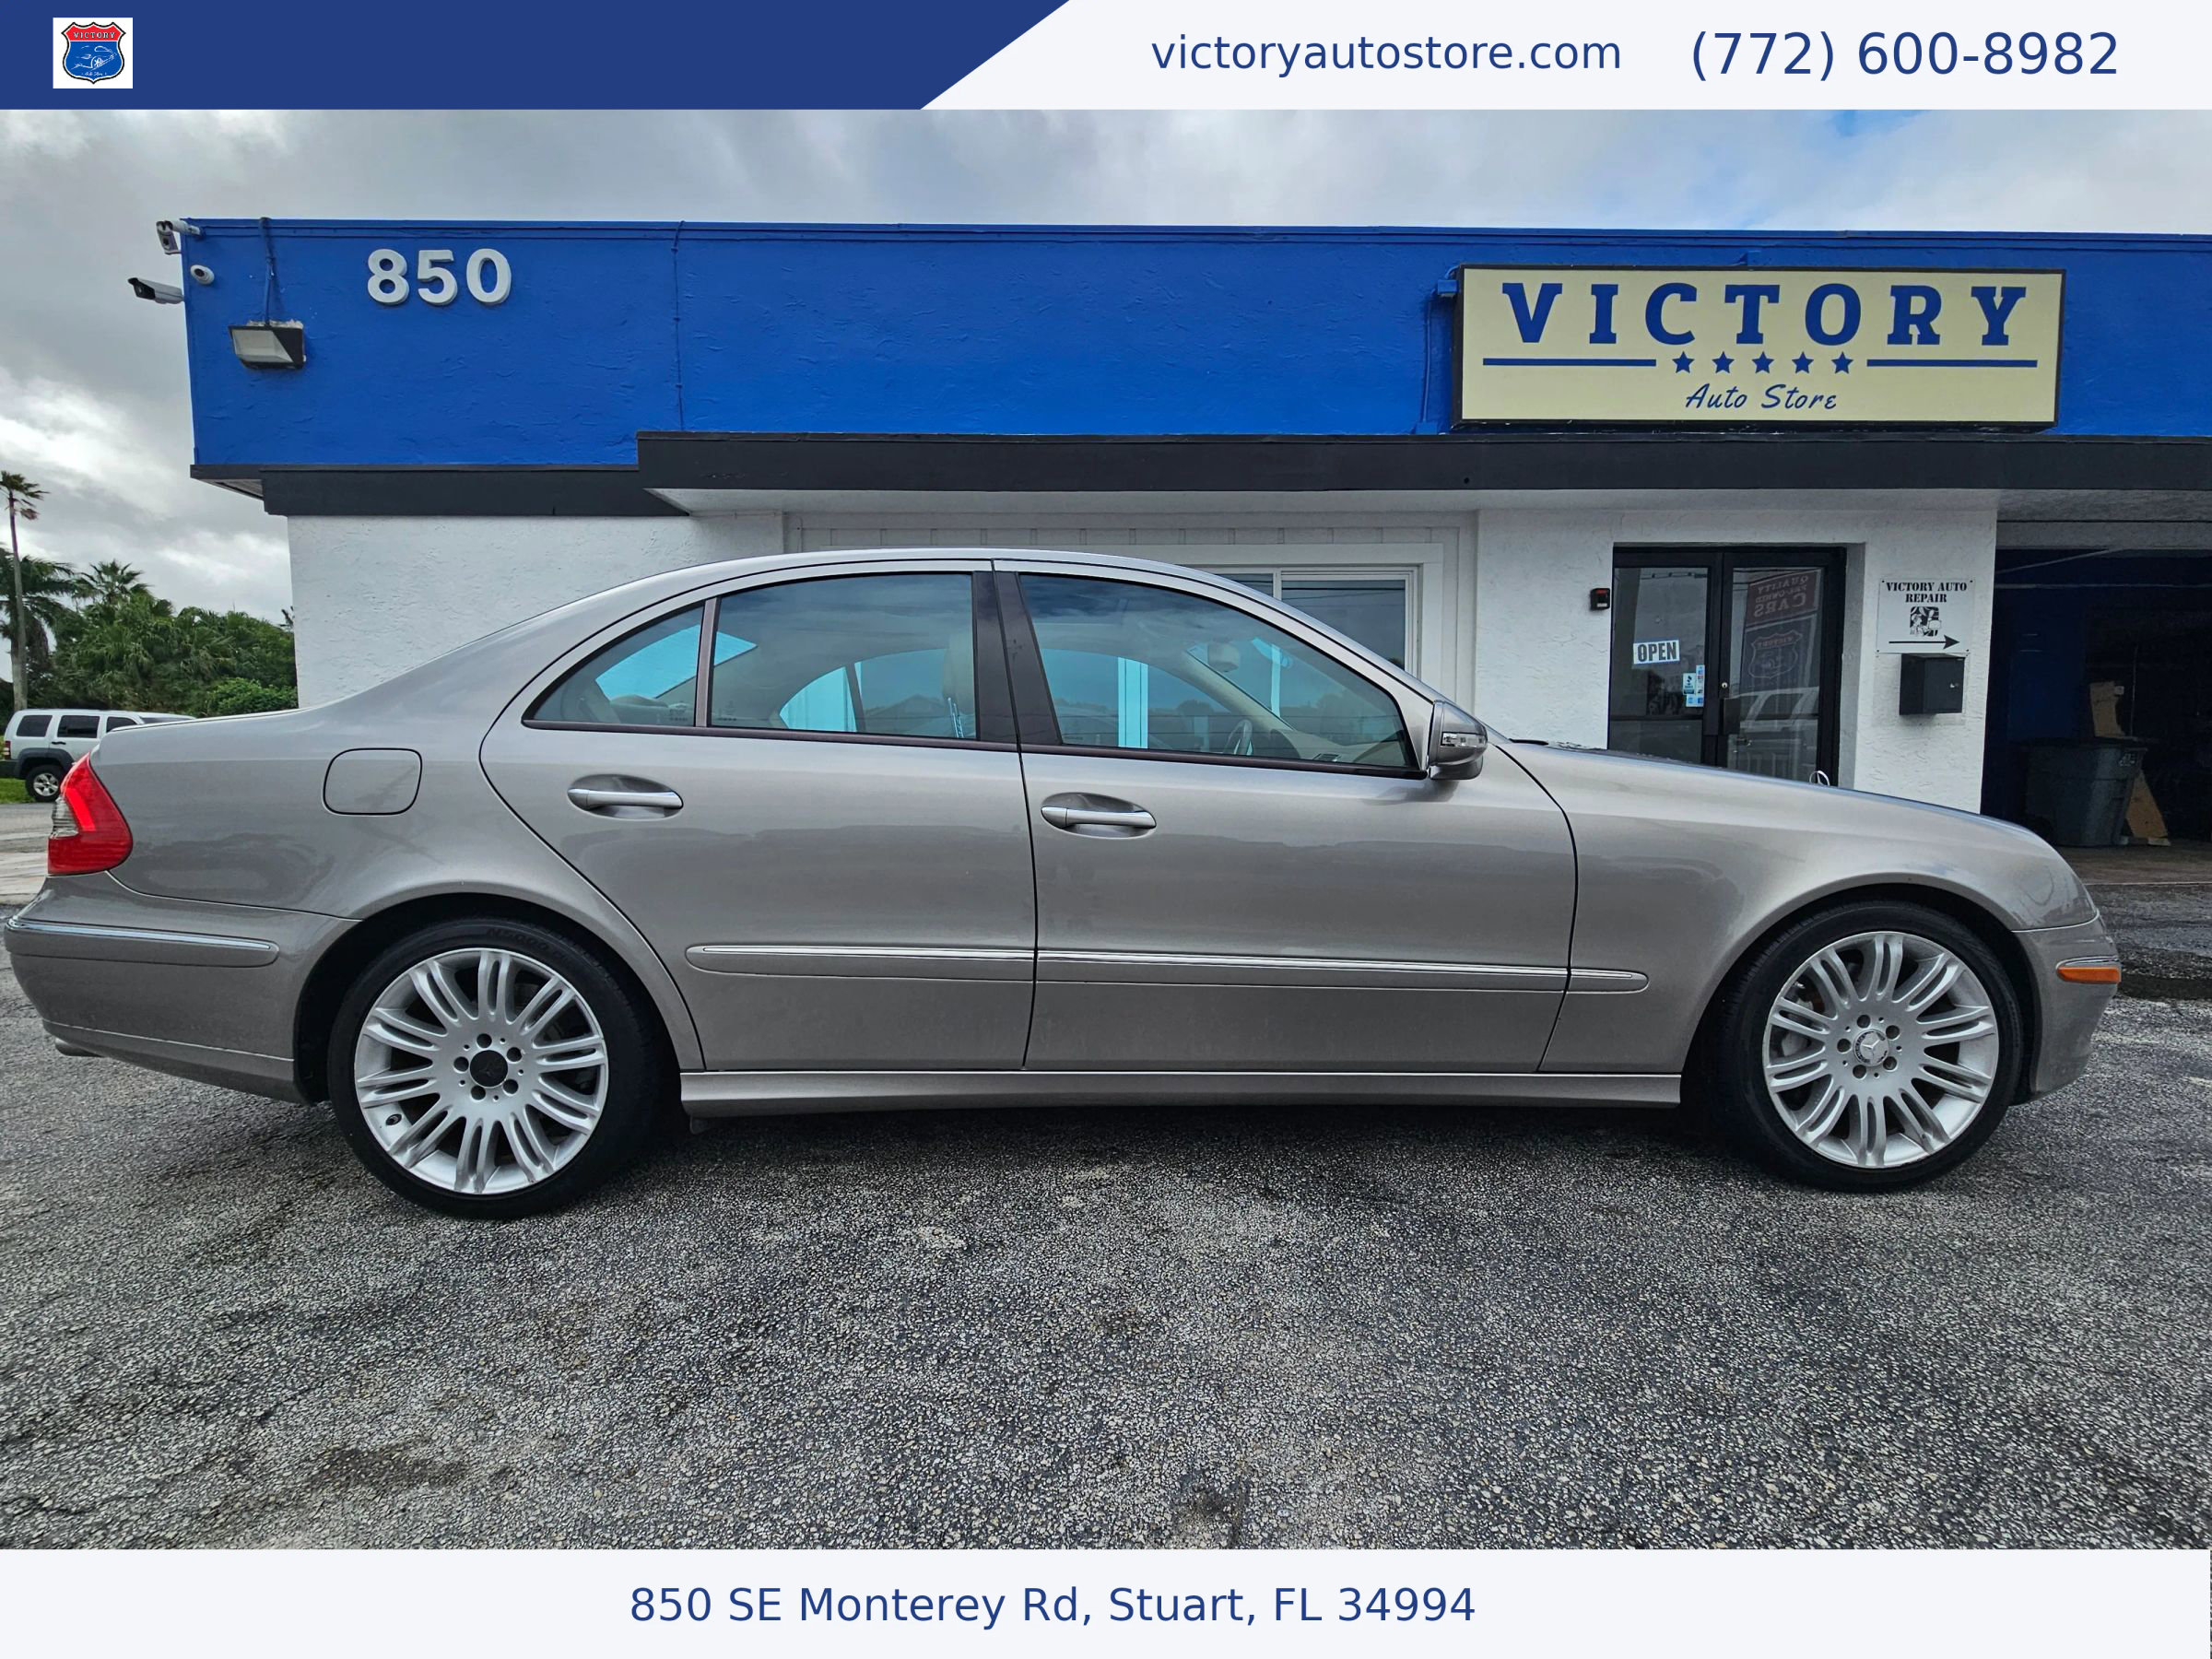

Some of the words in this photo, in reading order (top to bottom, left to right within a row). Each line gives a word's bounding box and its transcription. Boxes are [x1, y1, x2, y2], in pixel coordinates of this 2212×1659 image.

[367, 248, 512, 306] 850
[1501, 282, 2027, 347] VICTORY
[1685, 382, 1748, 409] Auto
[1760, 383, 1837, 410] Store
[1886, 582, 1936, 592] VICTORY
[1937, 582, 1968, 592] AUTO
[1905, 593, 1947, 603] REPAIR
[1637, 641, 1677, 662] OPEN
